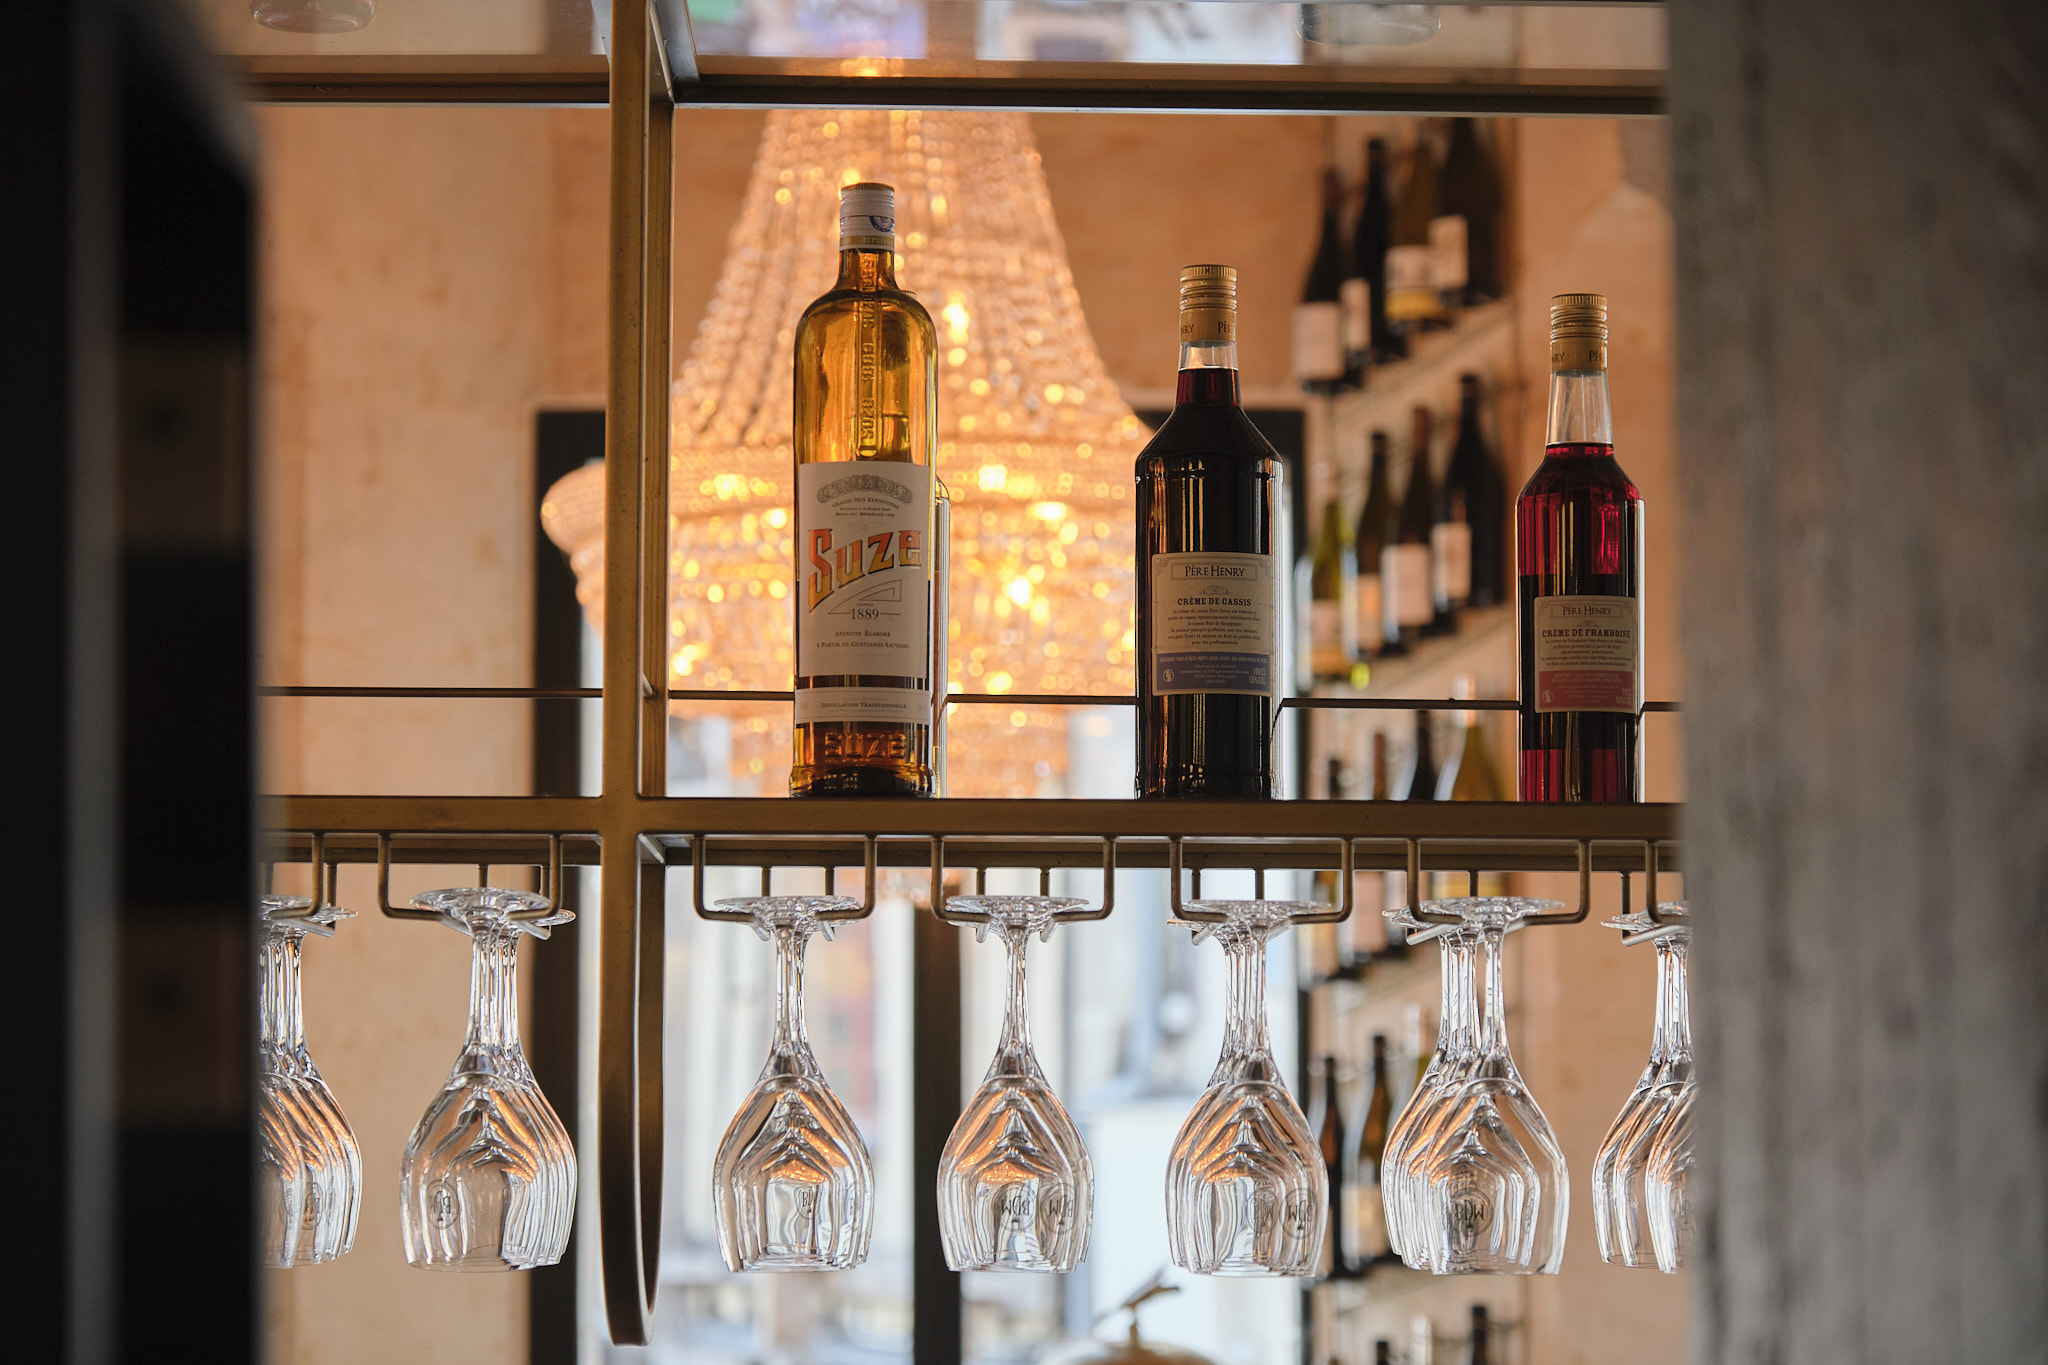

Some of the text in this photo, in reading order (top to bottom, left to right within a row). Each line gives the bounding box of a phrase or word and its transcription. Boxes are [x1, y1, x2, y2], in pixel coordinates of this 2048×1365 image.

[1185, 565, 1246, 577] PÈRE HENRY
[1177, 596, 1252, 607] CRÈME DE CASSIS
[851, 608, 879, 620] 1889
[1562, 605, 1613, 616] PÈRE HENRY
[1542, 628, 1630, 638] CRÈME DE FRAMBOISE
